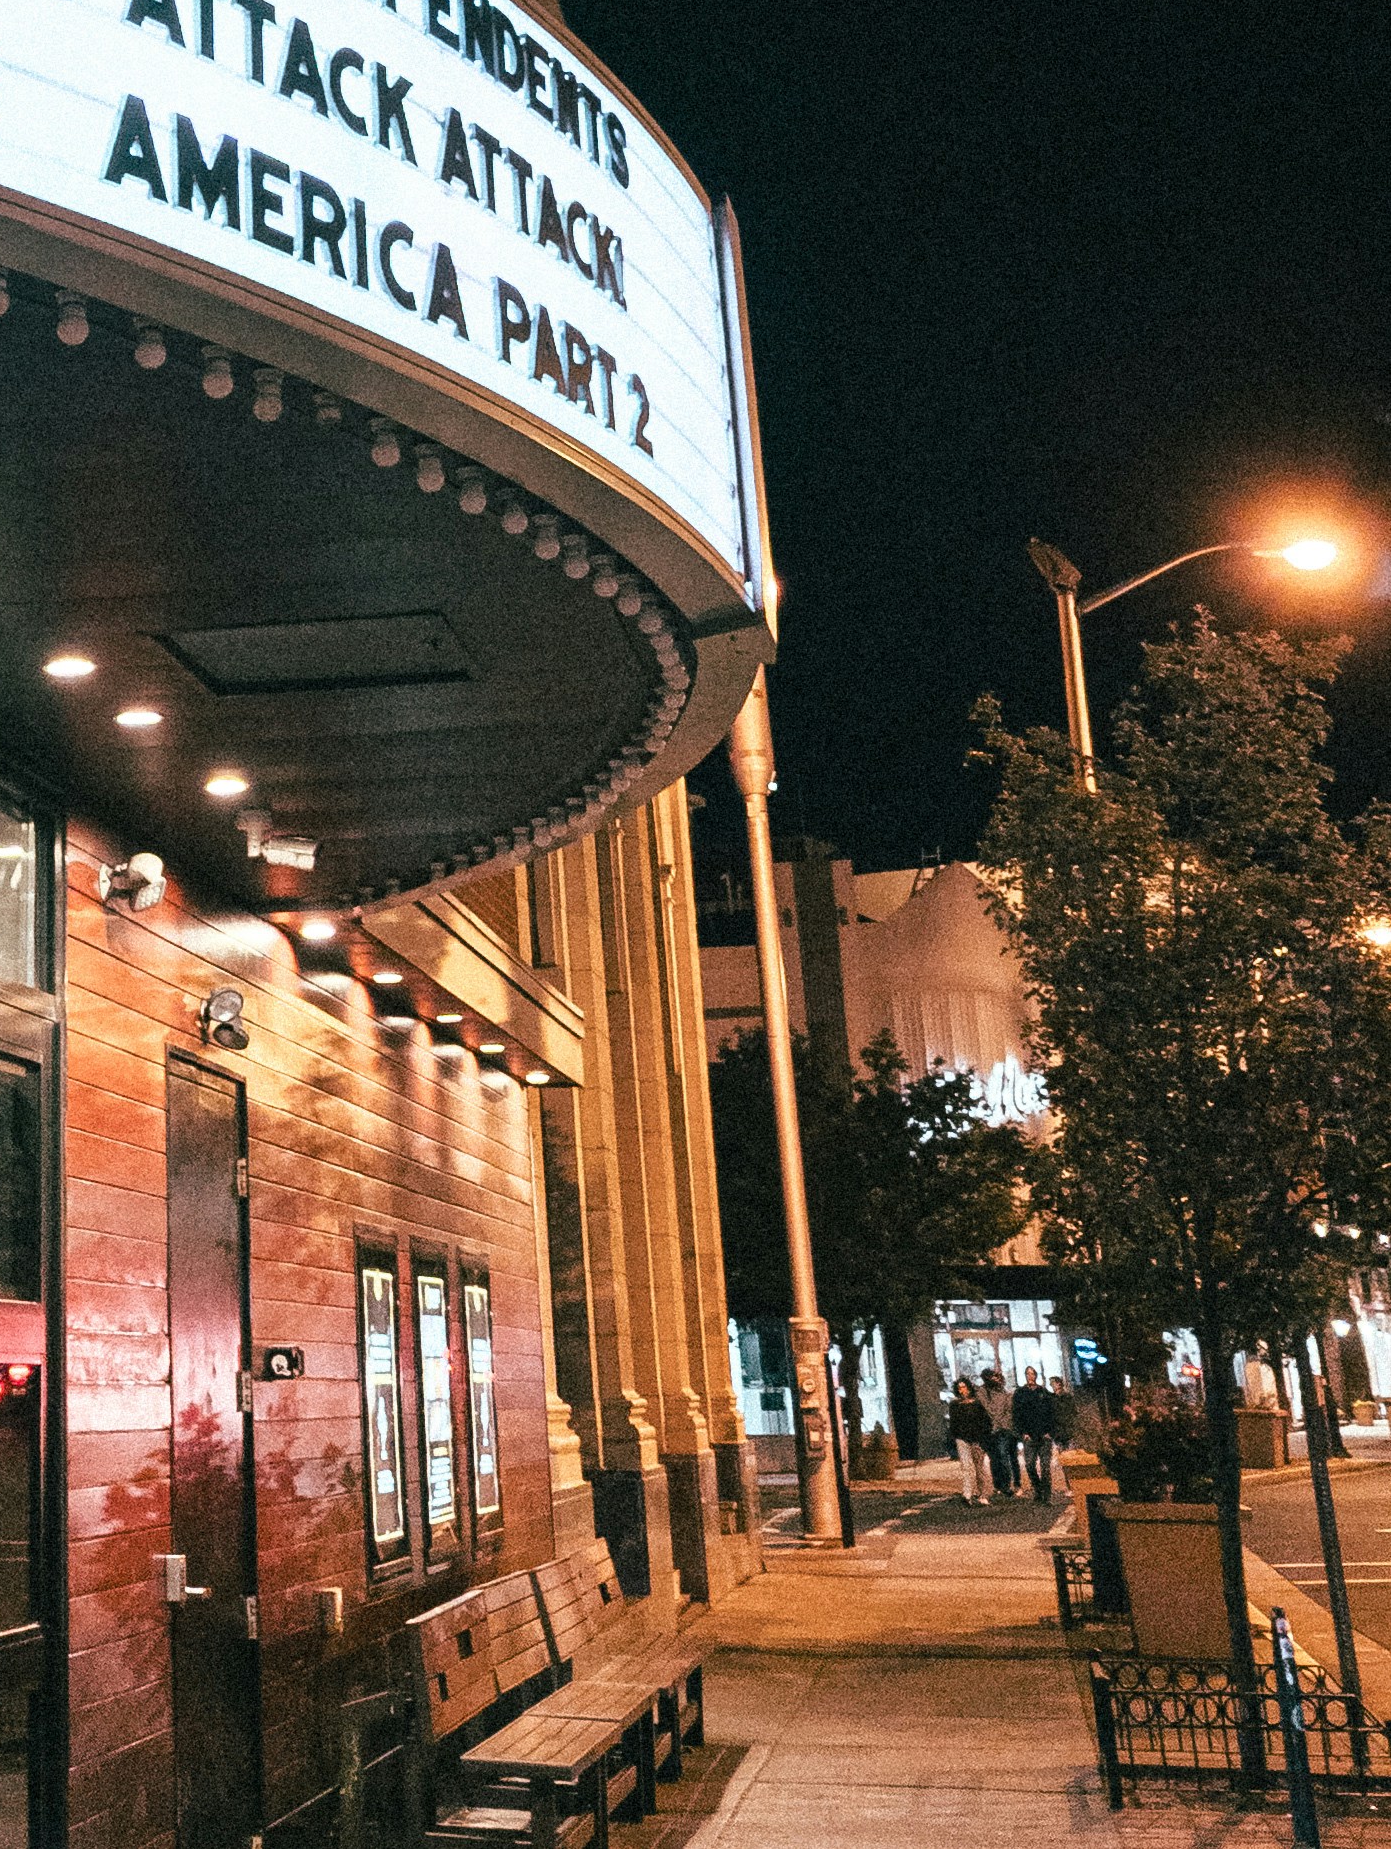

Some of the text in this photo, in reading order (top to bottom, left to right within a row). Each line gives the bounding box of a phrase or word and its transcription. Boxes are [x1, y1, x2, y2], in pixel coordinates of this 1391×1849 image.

[104, 96, 470, 341] AMERICA
[495, 276, 617, 432] PART
[630, 374, 655, 458] 2
